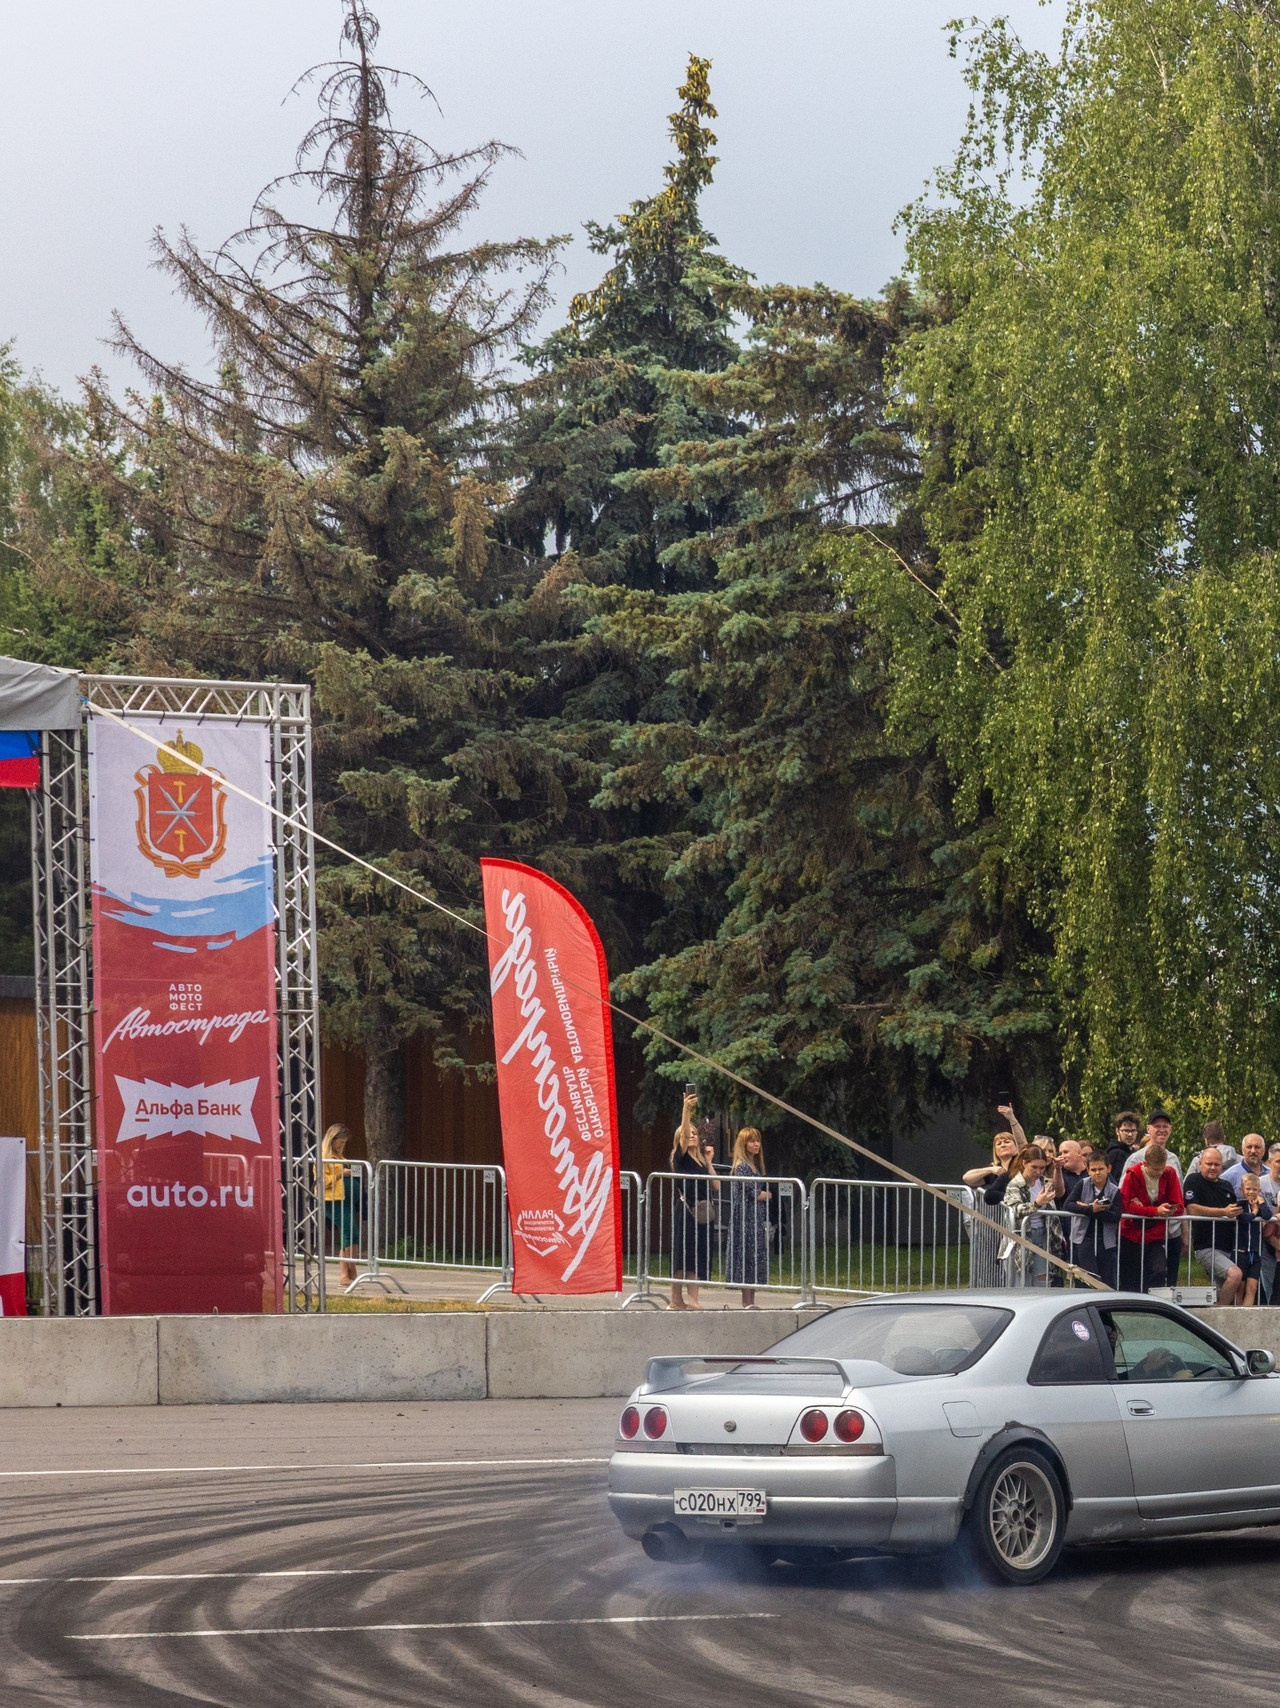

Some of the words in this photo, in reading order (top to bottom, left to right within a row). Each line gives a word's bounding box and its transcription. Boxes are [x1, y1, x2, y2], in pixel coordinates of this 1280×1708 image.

[169, 983, 202, 992] АВТО
[169, 993, 202, 1001] МОТО
[169, 1002, 203, 1011] ФЕСТ
[101, 1006, 270, 1053] Автострада
[134, 1098, 194, 1122] Альфа
[197, 1099, 242, 1116] Банк
[126, 1180, 254, 1208] auto.ru
[738, 1492, 762, 1507] 799
